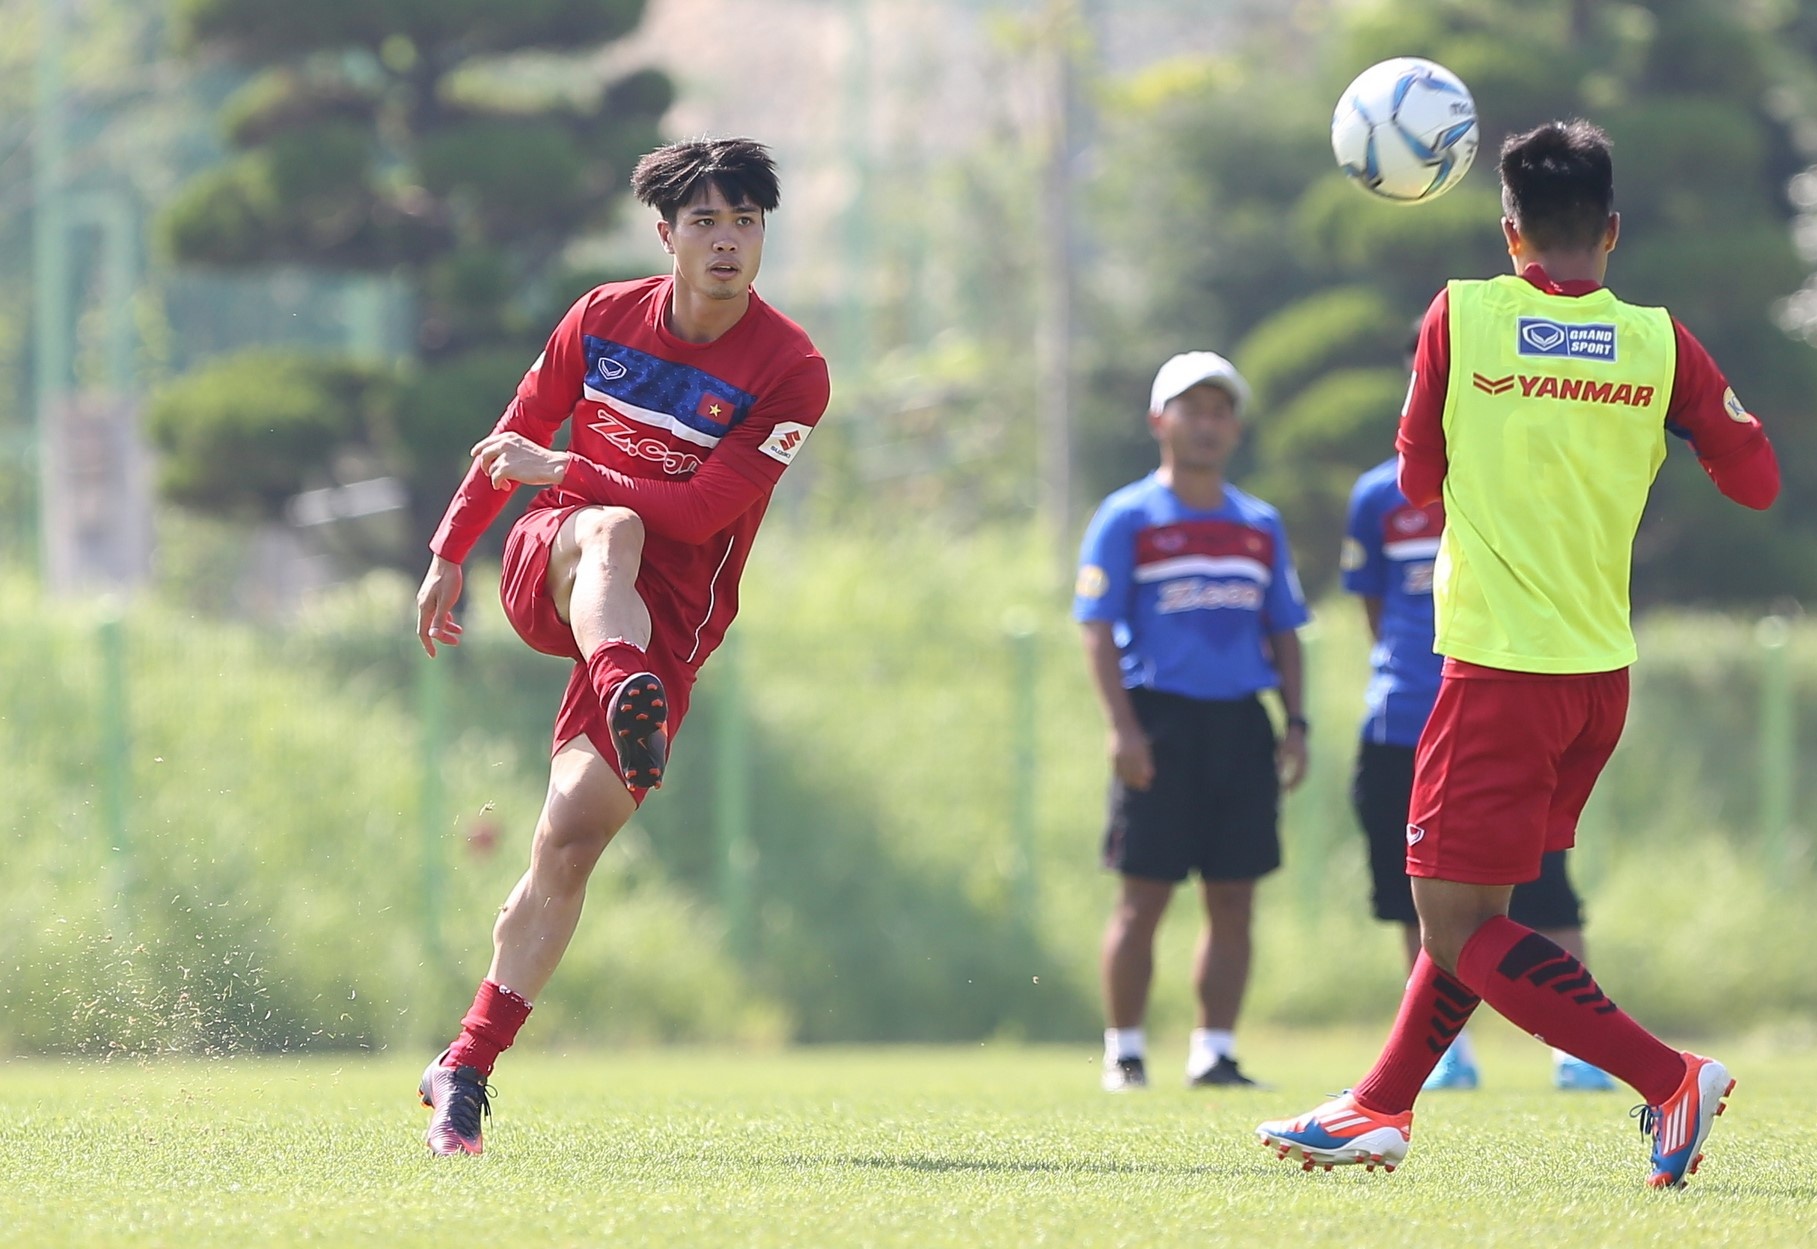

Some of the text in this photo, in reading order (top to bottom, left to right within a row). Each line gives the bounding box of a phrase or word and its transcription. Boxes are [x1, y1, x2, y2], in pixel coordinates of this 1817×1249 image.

[1569, 329, 1612, 342] GRAND
[1571, 341, 1612, 355] SPORT
[1518, 375, 1654, 407] YANMAR
